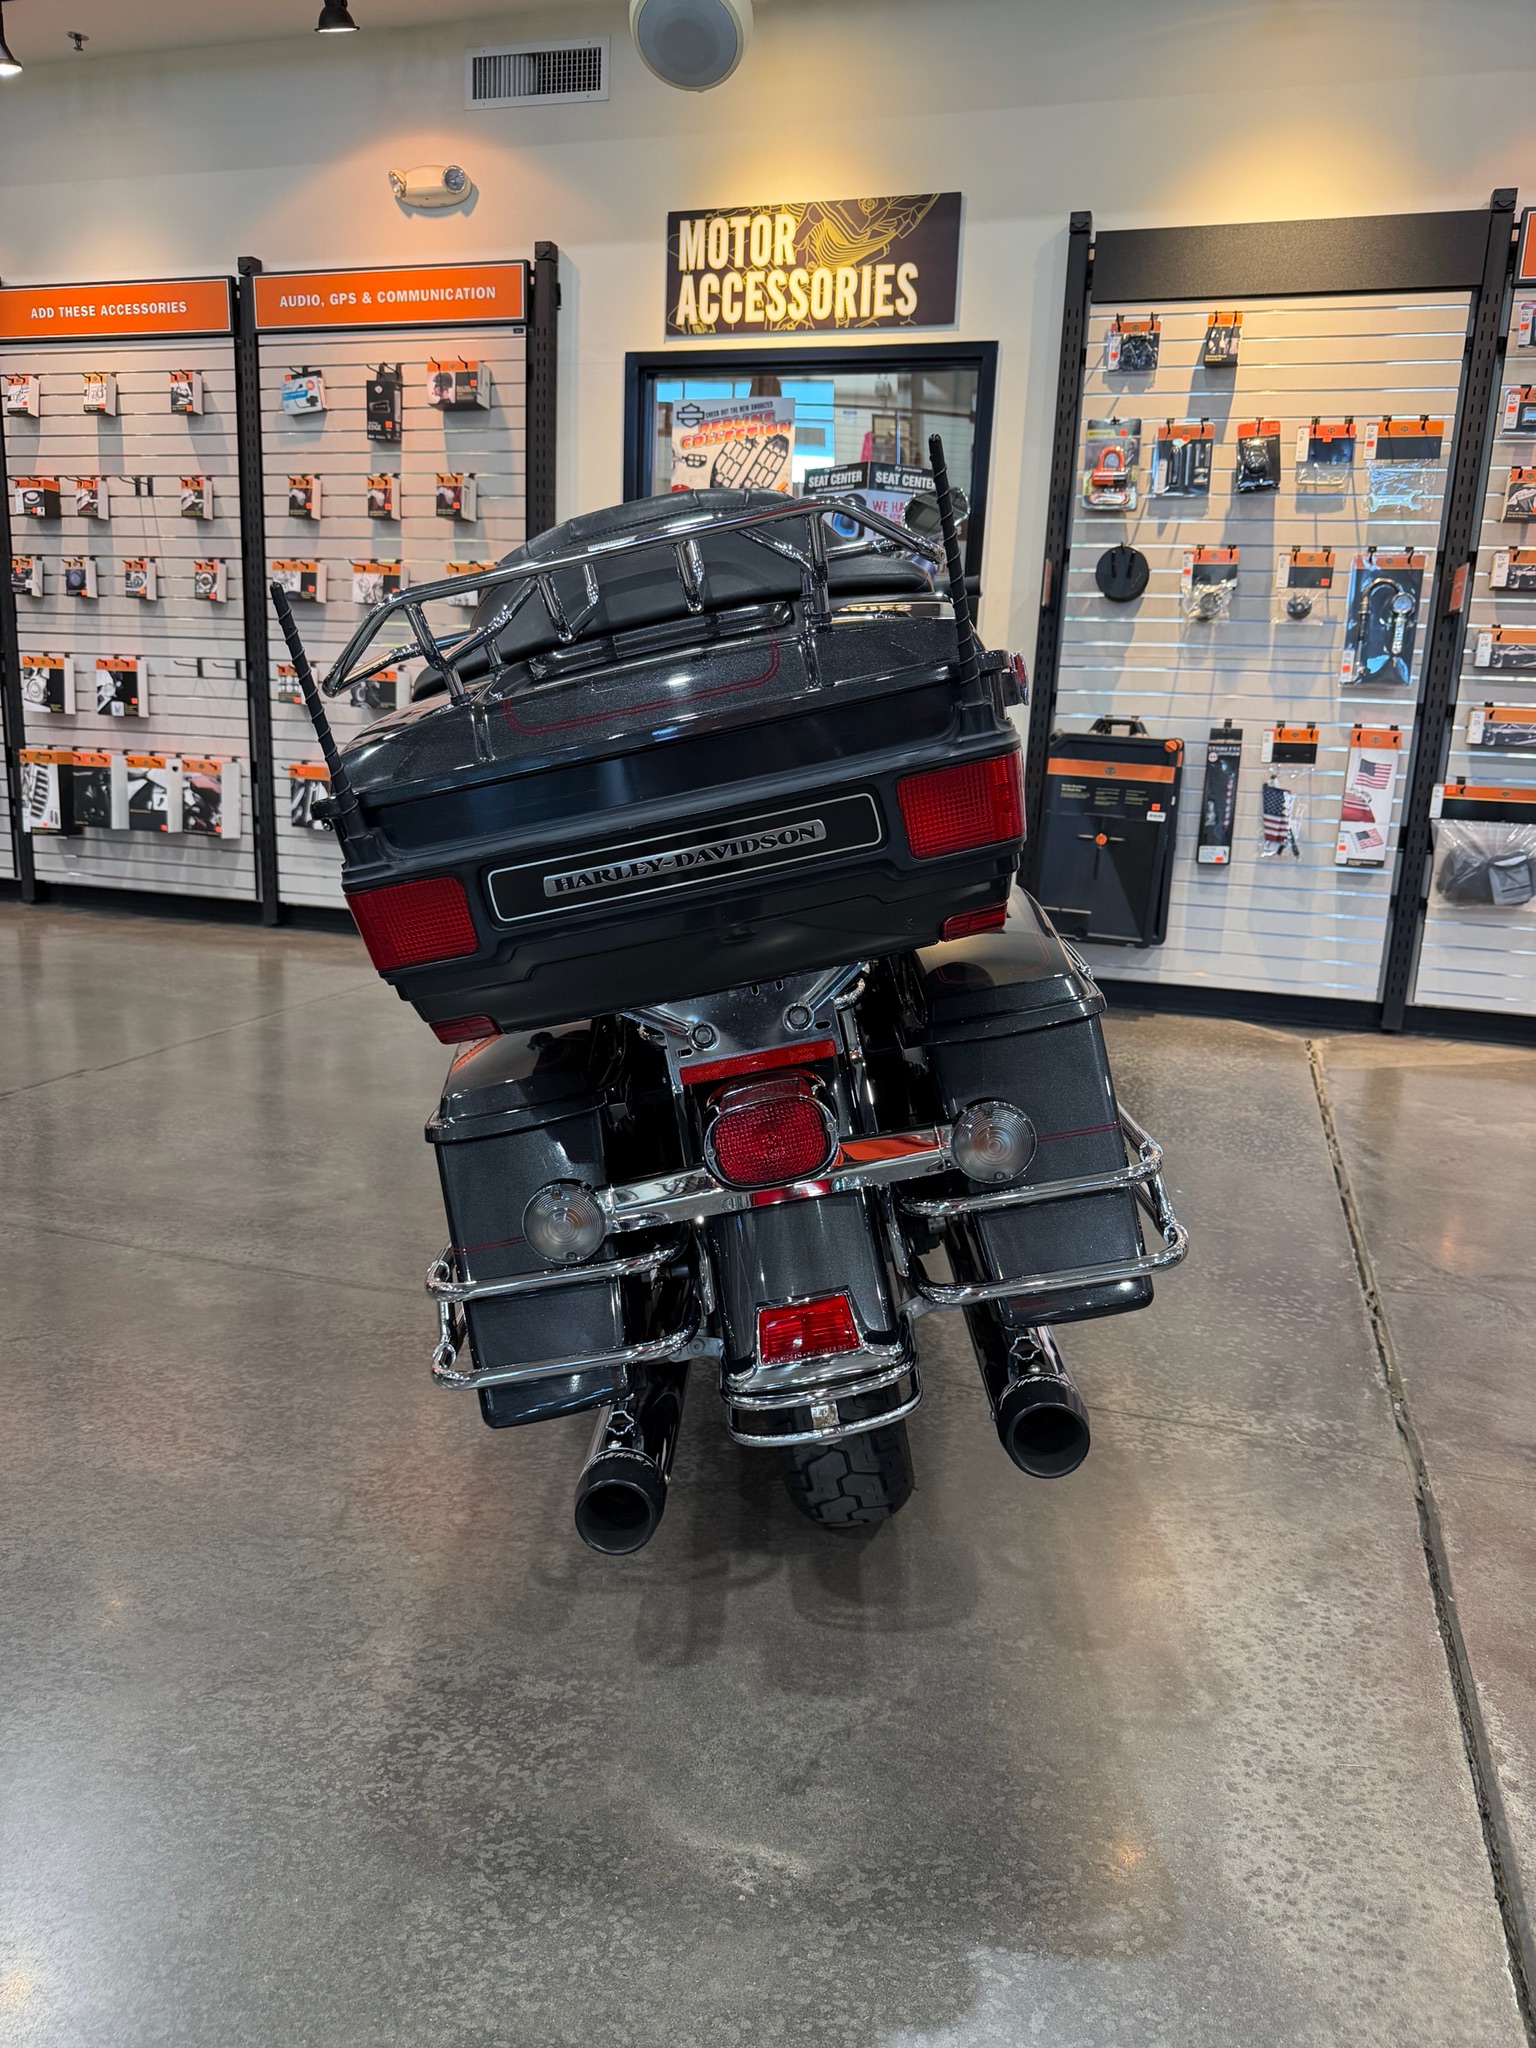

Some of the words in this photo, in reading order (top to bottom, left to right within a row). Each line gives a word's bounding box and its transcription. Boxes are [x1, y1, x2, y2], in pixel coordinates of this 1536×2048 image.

[679, 214, 797, 271] MOTOR
[279, 293, 325, 308] AUDIO,
[329, 292, 357, 305] GPS
[361, 291, 372, 304] &
[377, 286, 496, 303] COMMUNICATION
[675, 262, 919, 326] ACCESSORIES
[30, 307, 55, 319] ADD
[58, 305, 96, 317] THESE
[100, 301, 187, 316] ACCESSORIES
[730, 406, 738, 414] THE
[699, 410, 775, 434] REDLINE
[681, 419, 791, 449] COLLECTION
[808, 475, 829, 488] SEAT
[831, 470, 862, 485] CENTER
[875, 471, 900, 485] SEAT
[872, 501, 888, 512] WE
[552, 825, 819, 893] HARLEY-DAVIDSON
